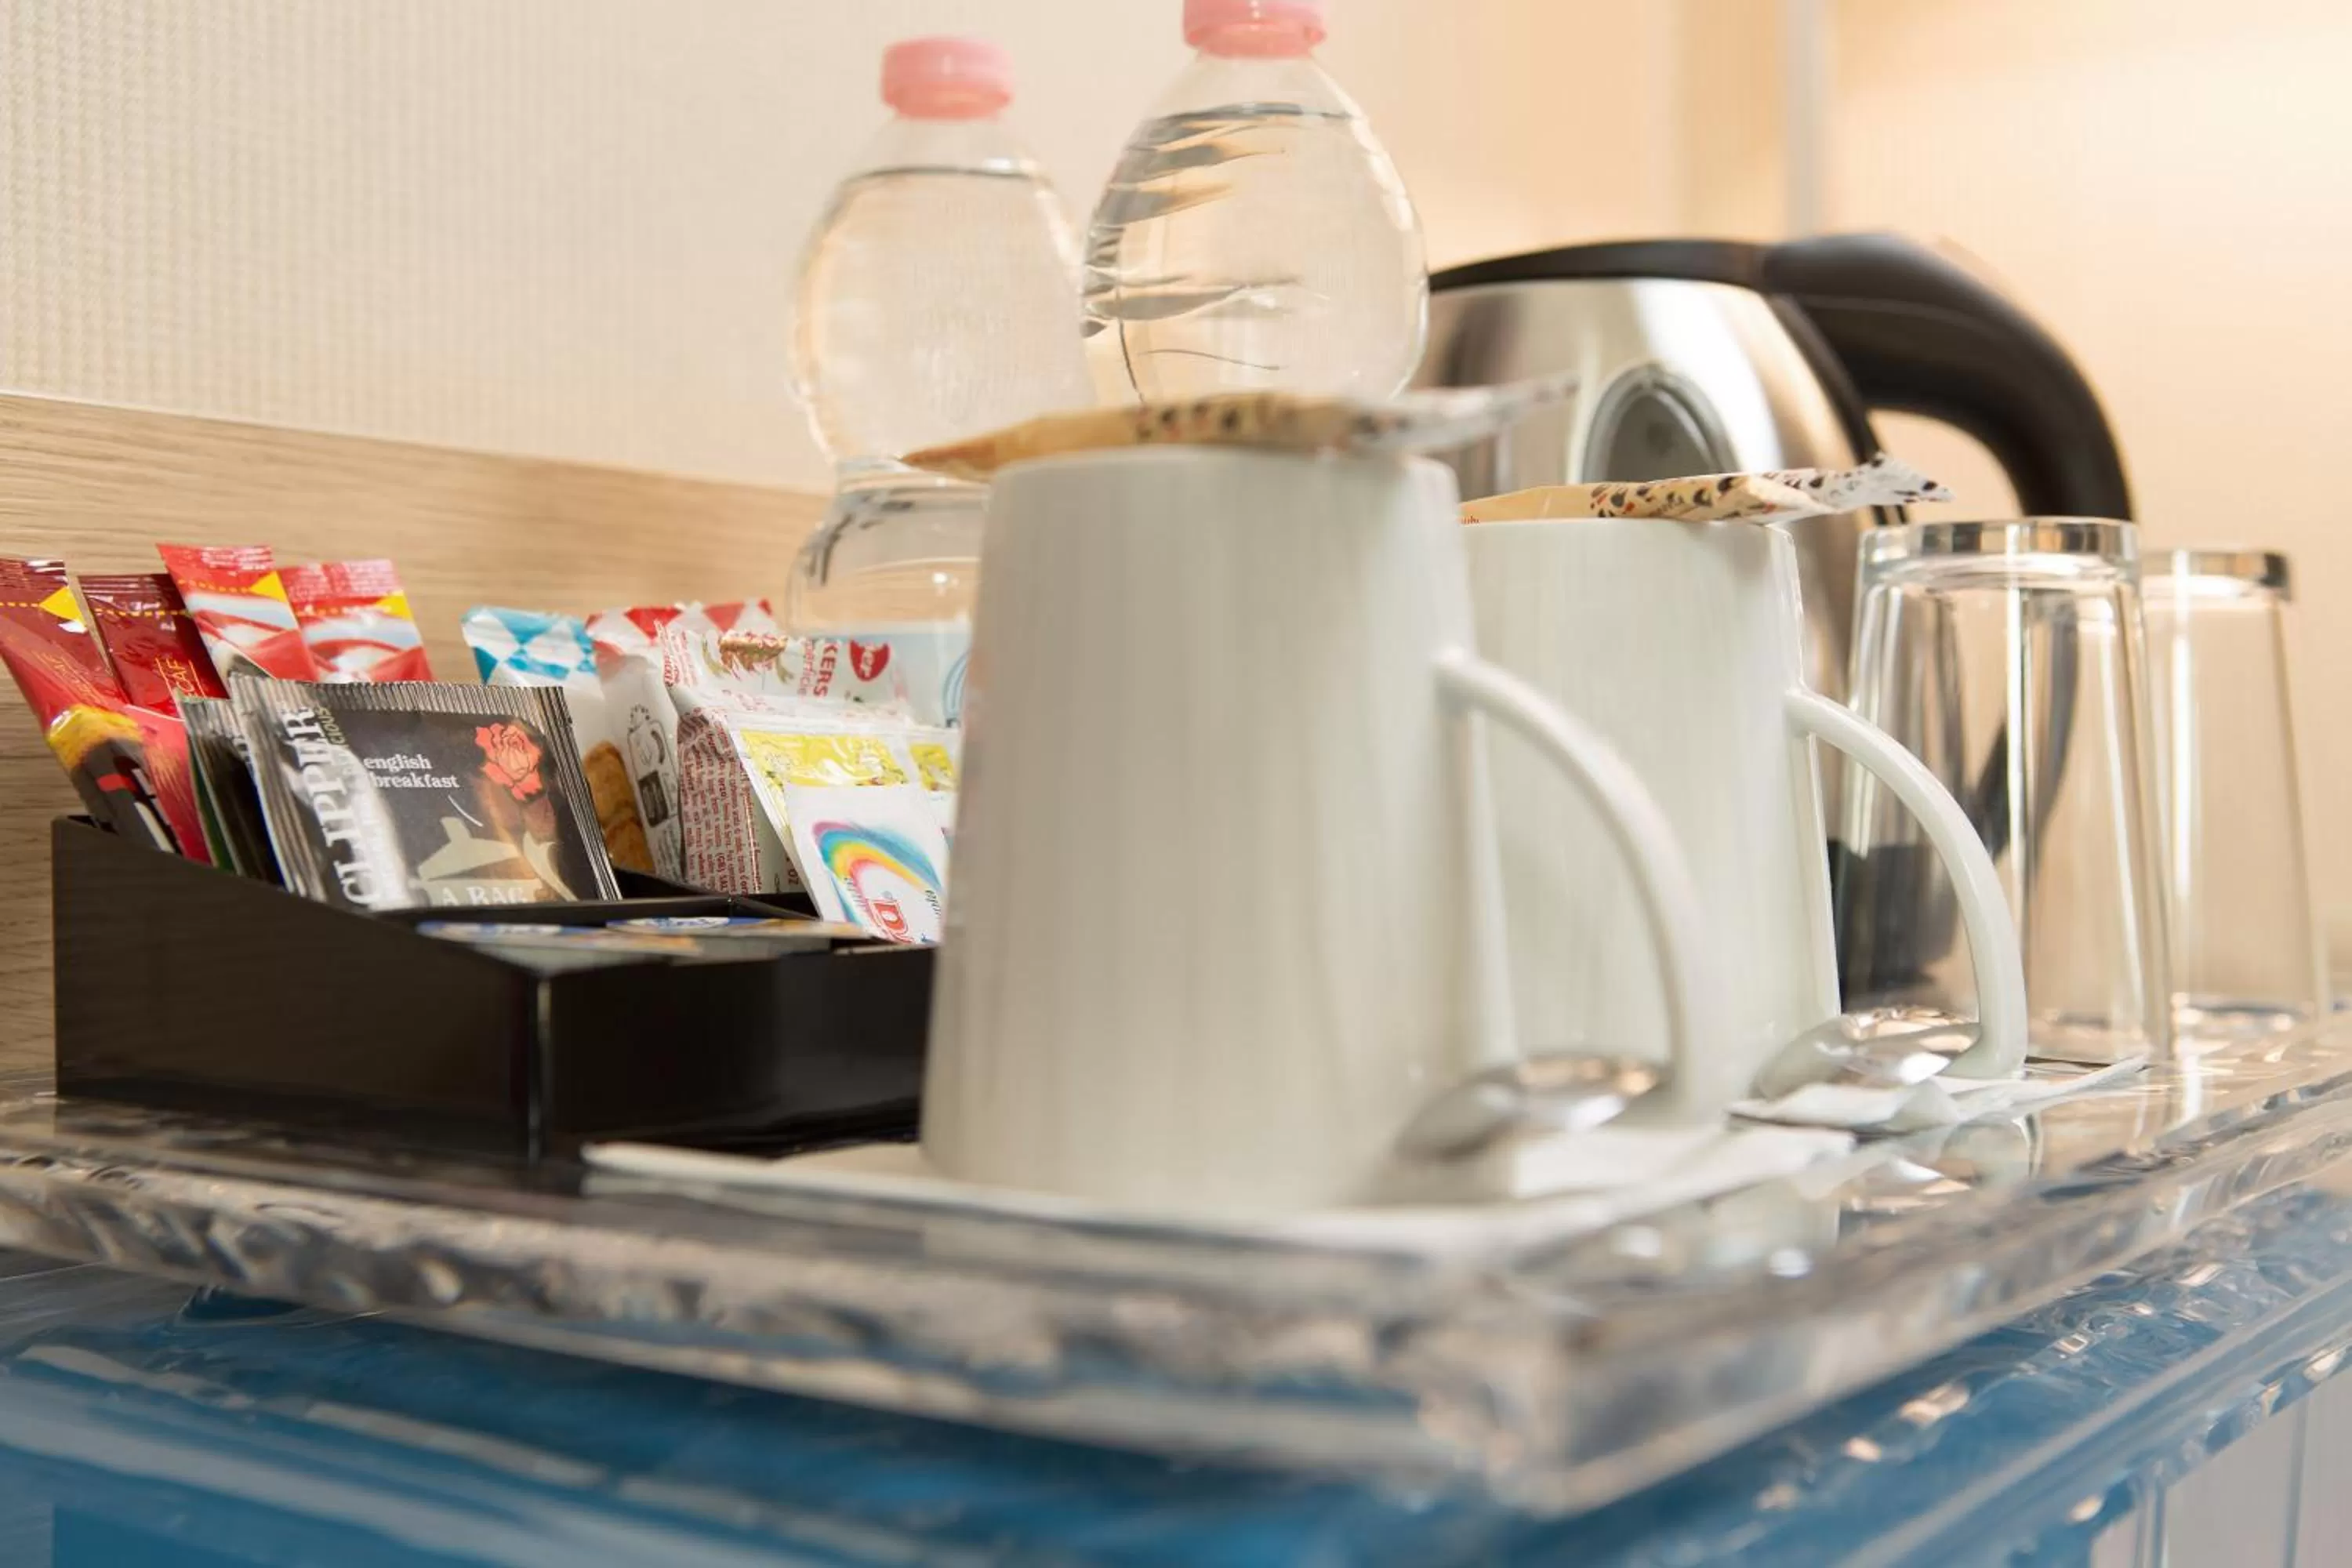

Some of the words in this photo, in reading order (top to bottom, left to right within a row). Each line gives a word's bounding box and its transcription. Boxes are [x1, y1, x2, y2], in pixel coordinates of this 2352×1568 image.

[363, 753, 432, 772] english
[371, 771, 460, 789] breakfast
[280, 705, 381, 906] CLIPPER
